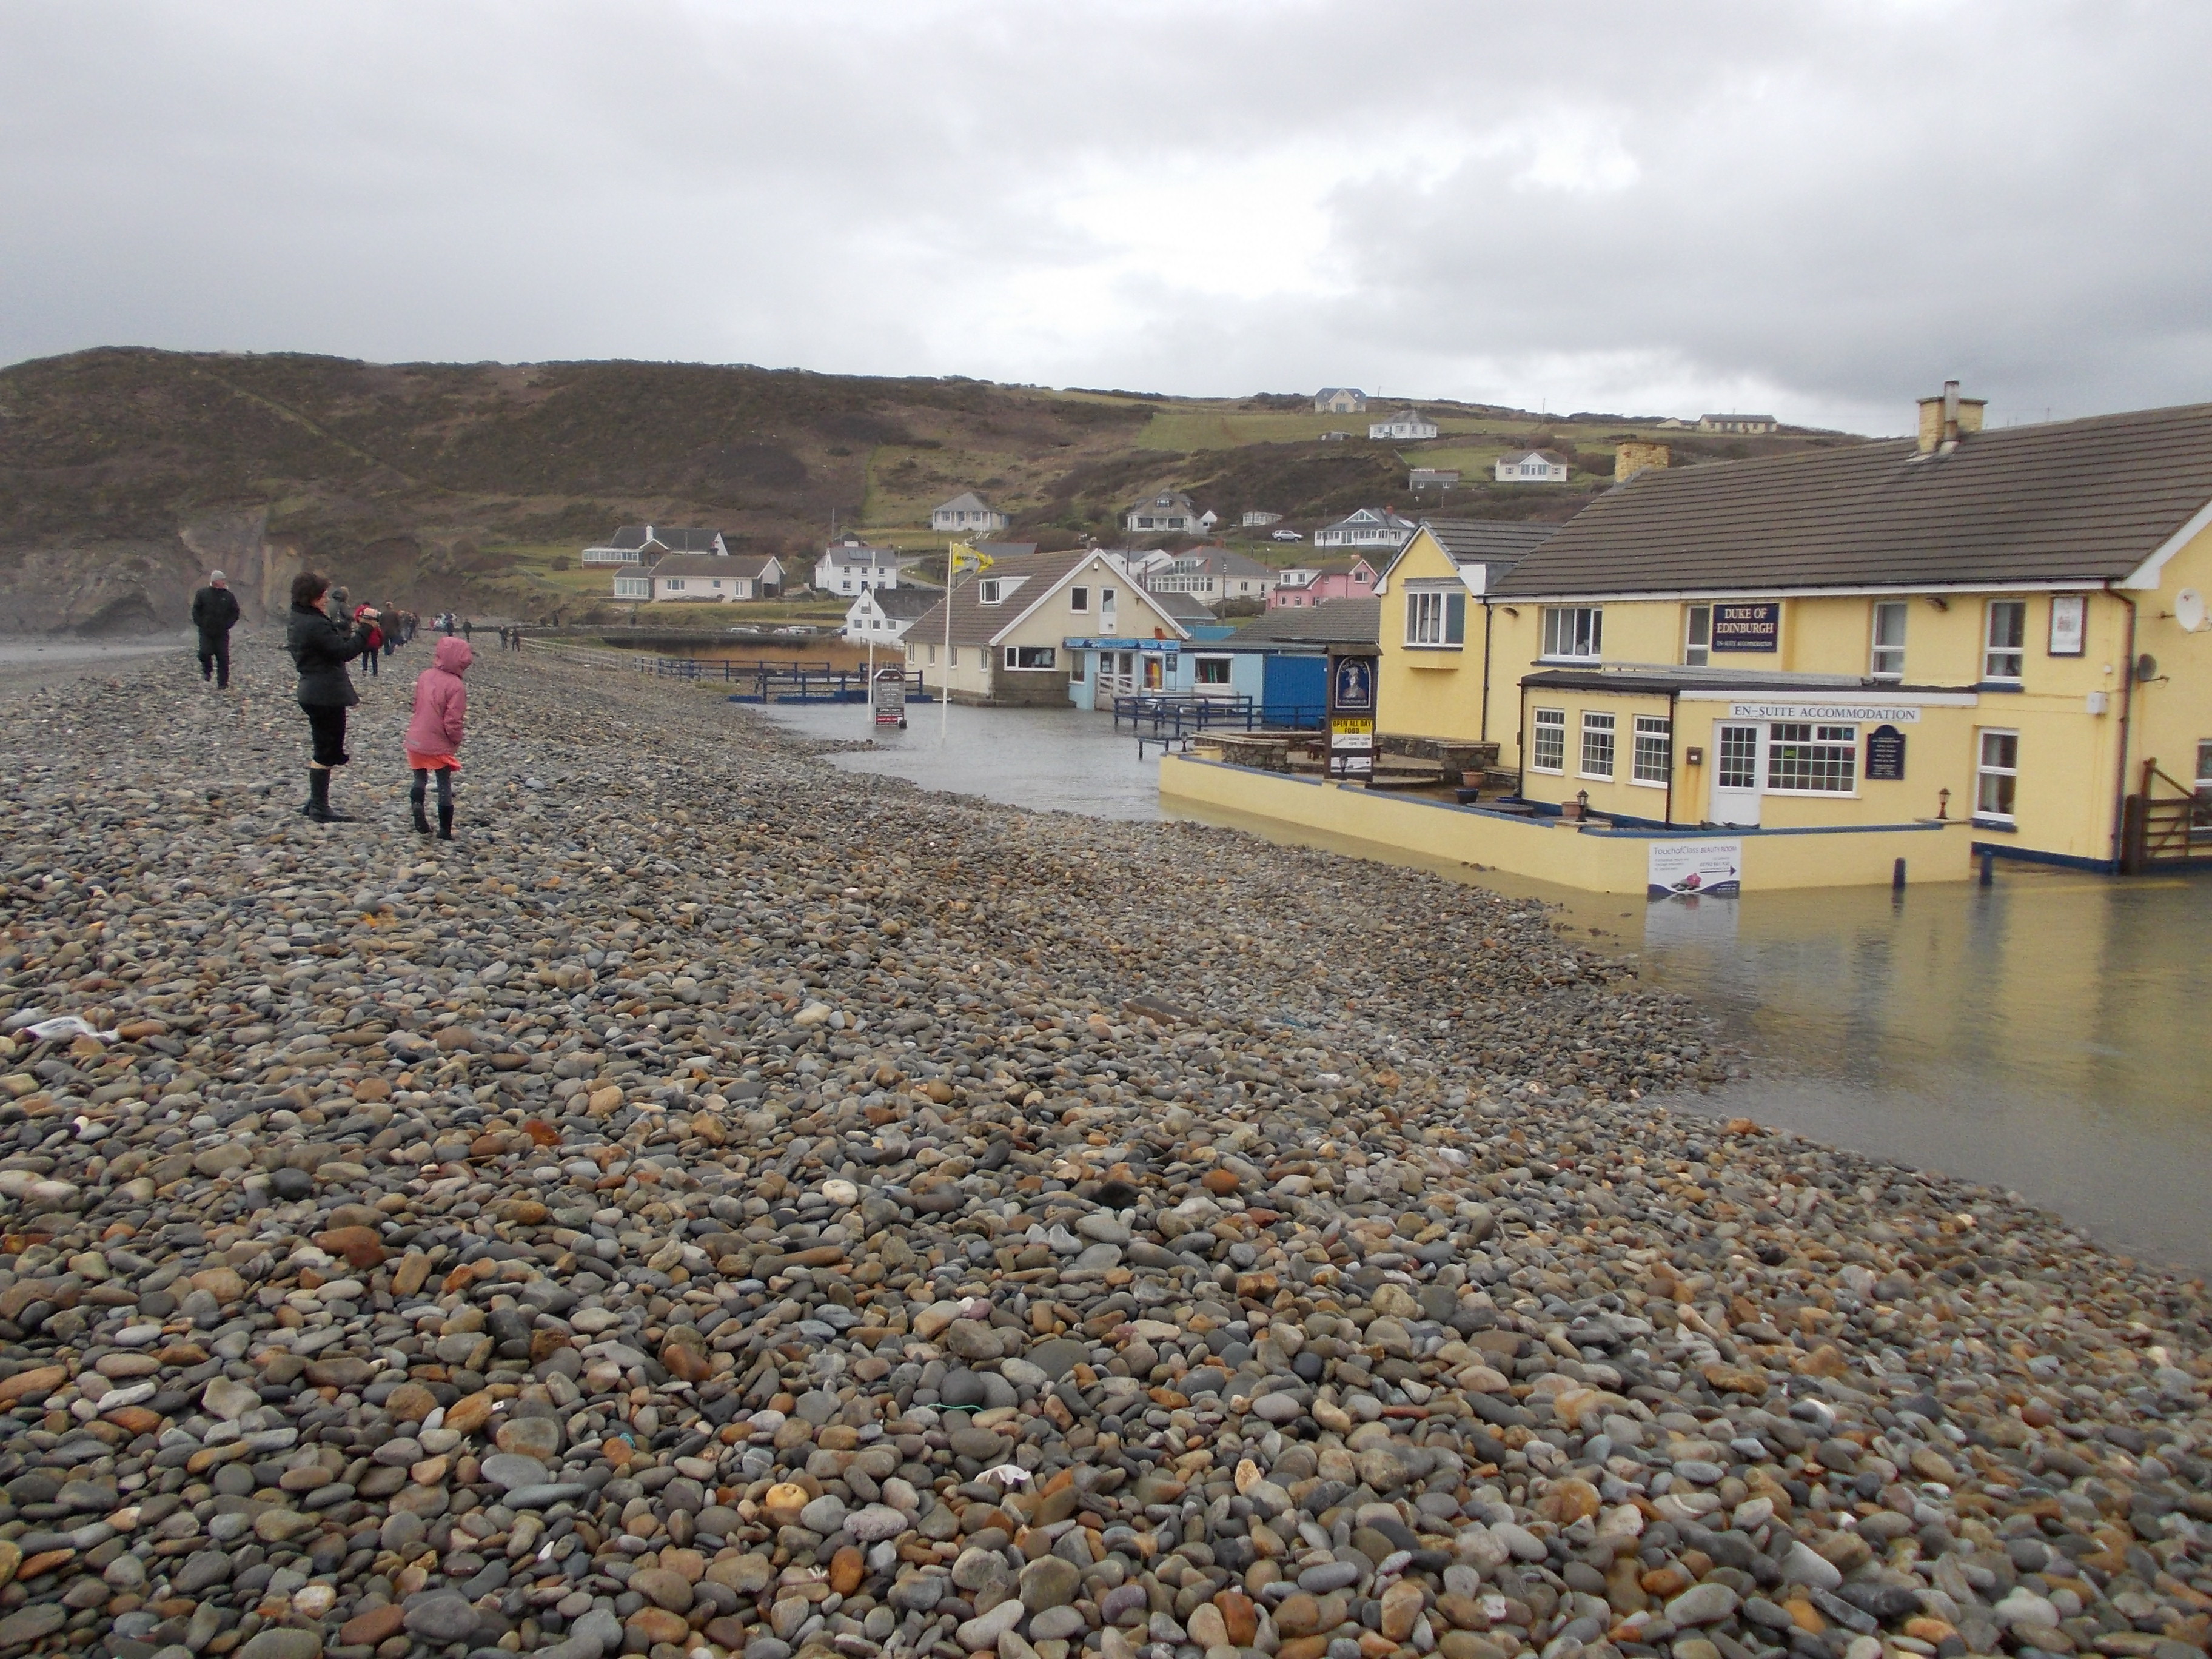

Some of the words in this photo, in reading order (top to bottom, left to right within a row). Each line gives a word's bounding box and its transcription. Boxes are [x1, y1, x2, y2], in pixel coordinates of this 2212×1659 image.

[1724, 608, 1752, 619] DUKE
[1754, 608, 1767, 618] OF
[1717, 623, 1774, 634] EDINBURGH
[1734, 706, 1794, 717] EN-SUITE
[1800, 708, 1915, 720] ACCOMMODATION
